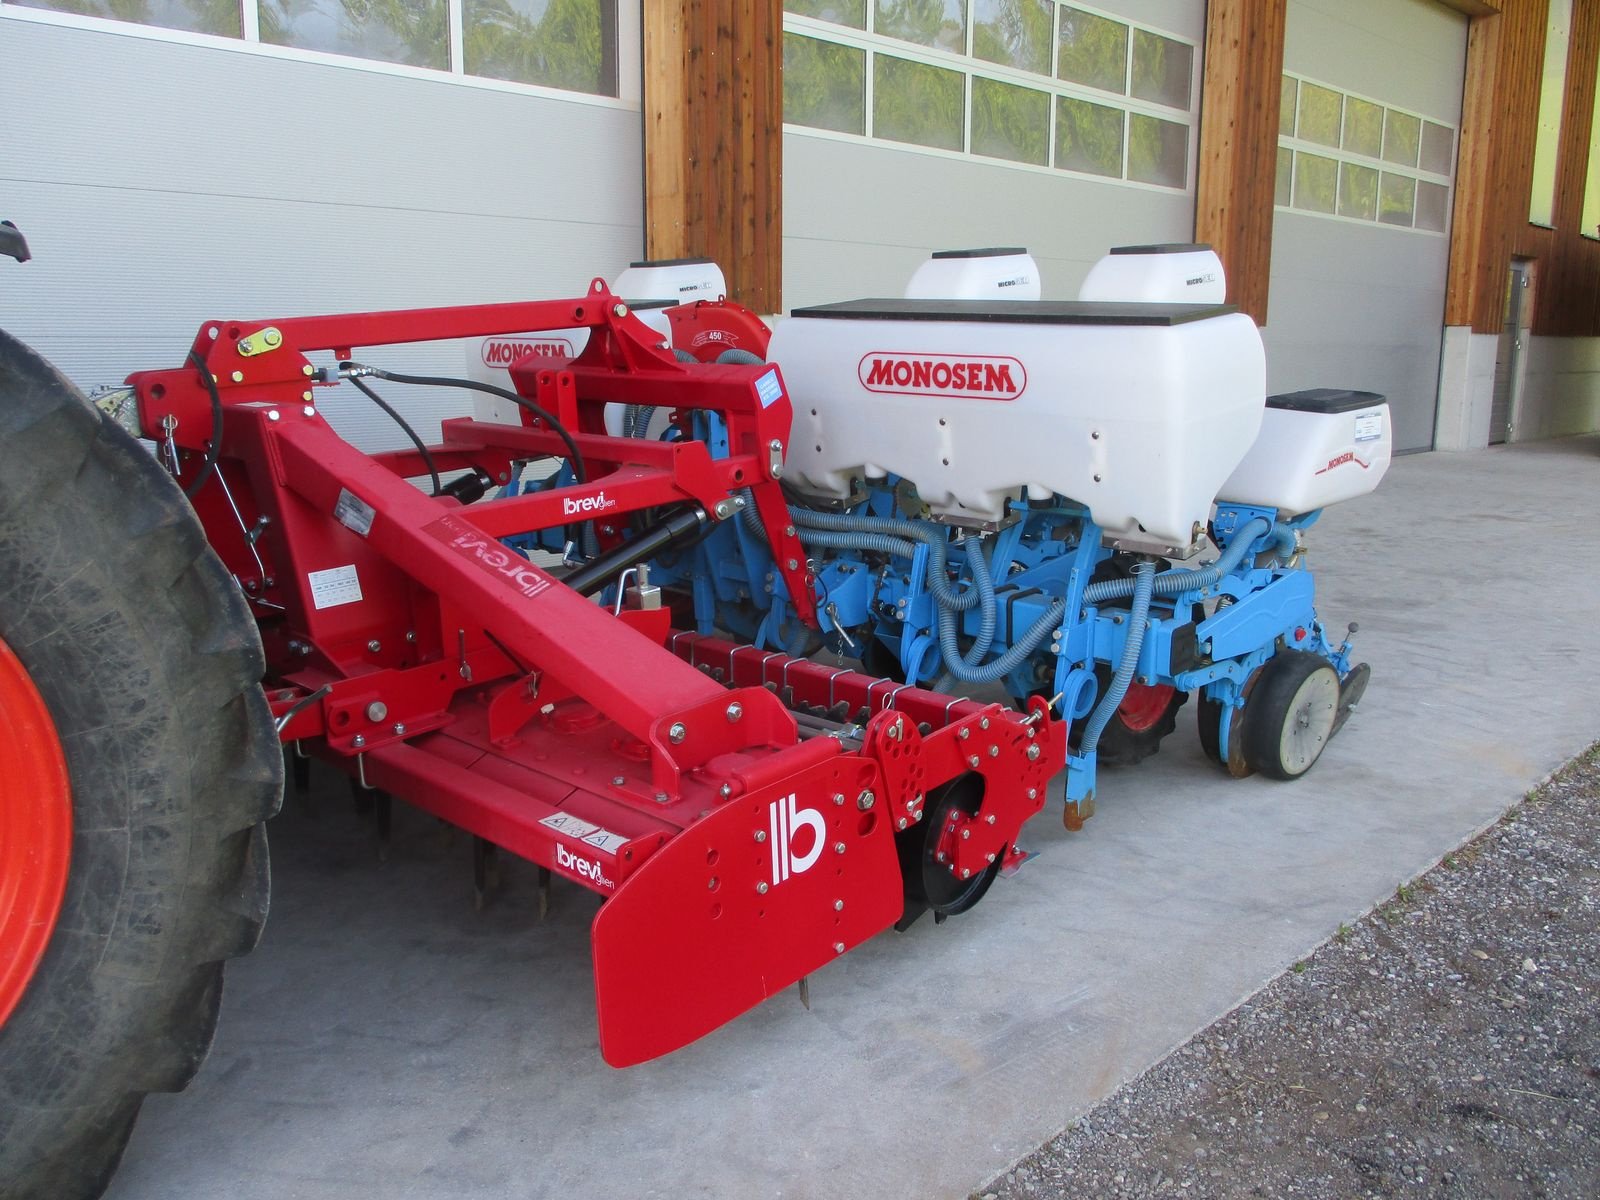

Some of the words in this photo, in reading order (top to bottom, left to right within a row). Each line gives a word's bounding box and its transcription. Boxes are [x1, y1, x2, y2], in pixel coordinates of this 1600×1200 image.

[709, 332, 722, 340] 450
[867, 359, 1017, 393] MONOSEM
[563, 491, 604, 515] brevi
[450, 537, 551, 597] brevi
[556, 842, 601, 880] brevi
